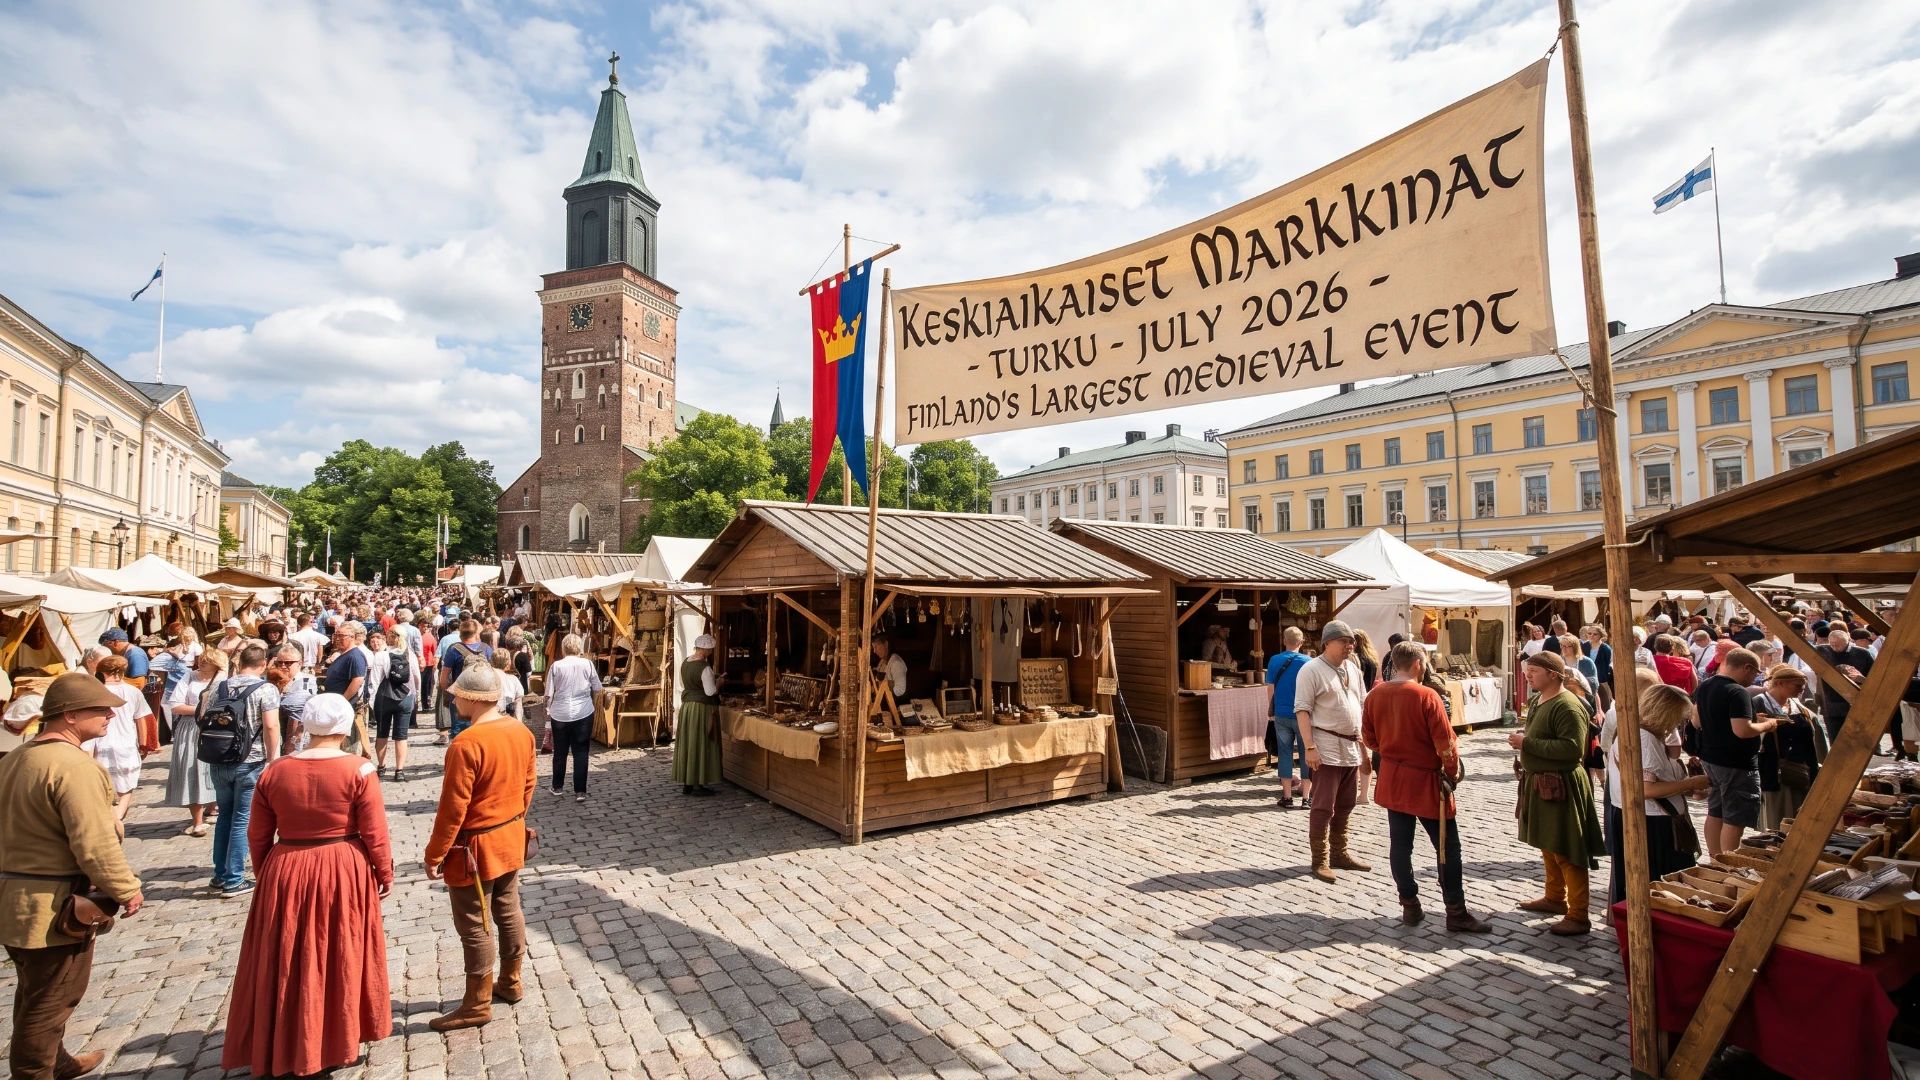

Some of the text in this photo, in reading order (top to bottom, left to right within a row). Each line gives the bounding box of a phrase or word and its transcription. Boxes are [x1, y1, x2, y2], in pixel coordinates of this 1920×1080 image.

[989, 334, 1097, 379] TURKU
[1137, 305, 1222, 365] JULY
[1241, 271, 1348, 335] 2026
[1031, 372, 1152, 417] LARGEST
[1165, 327, 1344, 397] MEDIEVAL
[1364, 288, 1520, 361] EVENT
